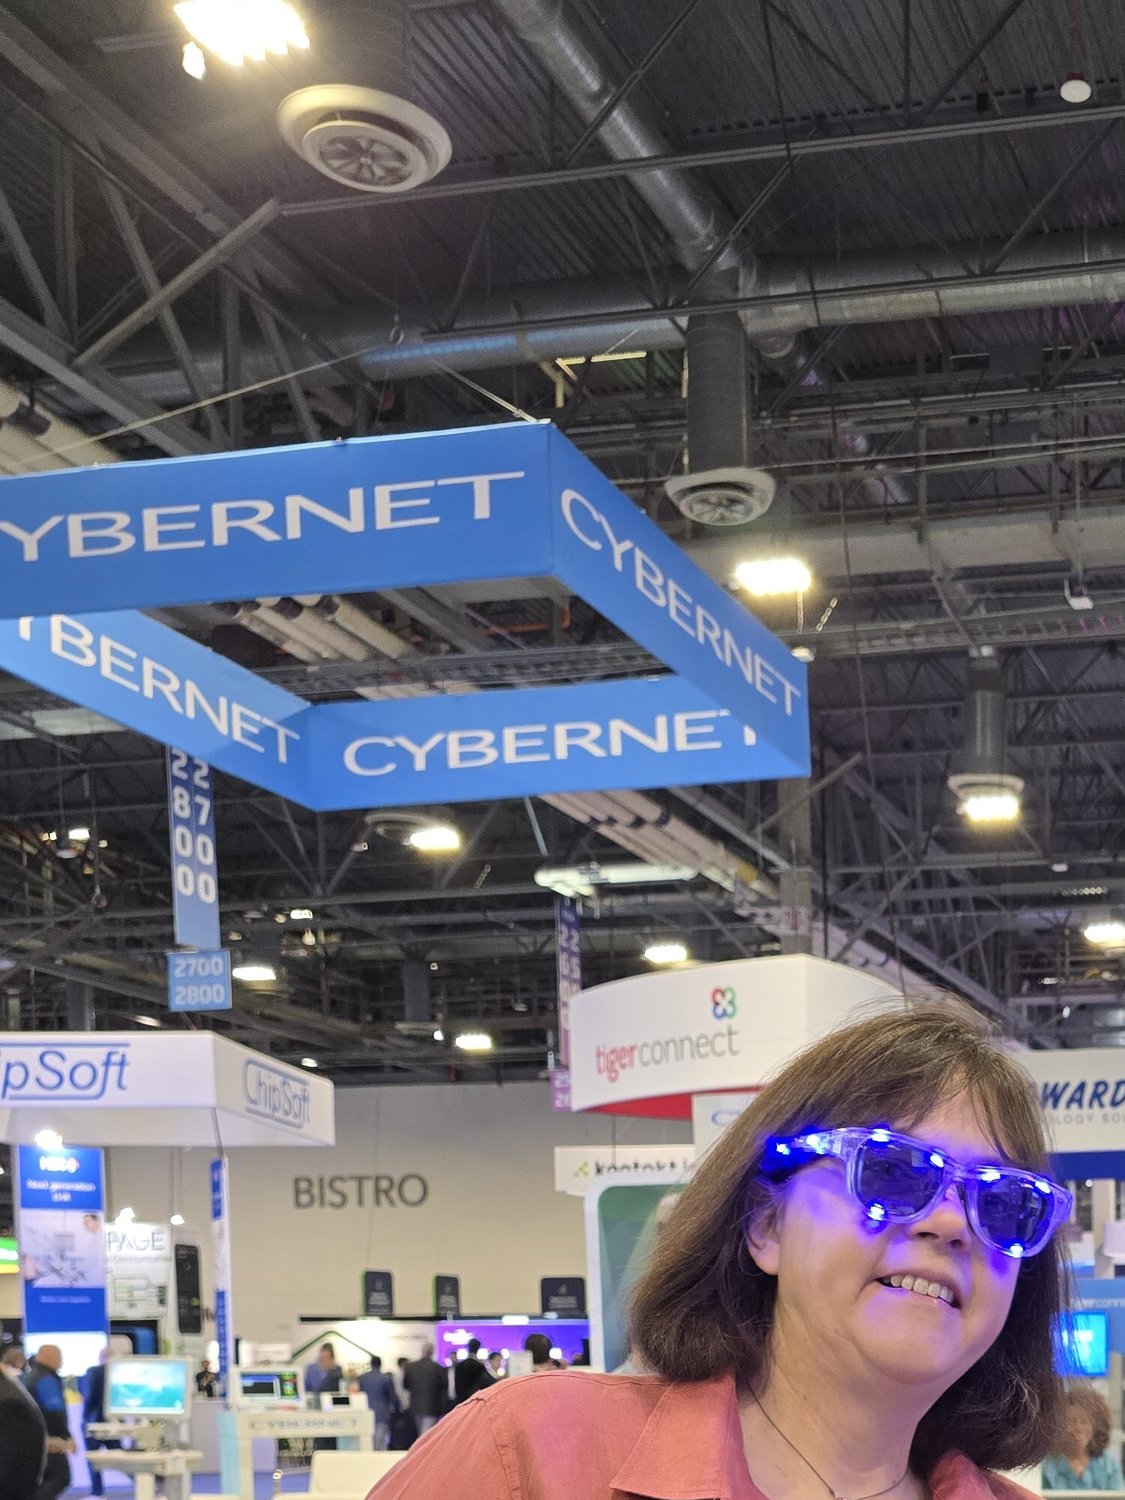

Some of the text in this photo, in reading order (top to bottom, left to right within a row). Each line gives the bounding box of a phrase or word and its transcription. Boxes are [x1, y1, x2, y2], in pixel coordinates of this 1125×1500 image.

[0, 471, 525, 562] YBERNET
[560, 488, 801, 716] CYBERNET
[18, 614, 301, 764] BERNET
[174, 955, 224, 978] 2700
[175, 983, 226, 1006] 2800
[1, 1049, 131, 1100] pSoft
[595, 1024, 741, 1083] tigerconnect
[244, 1060, 311, 1126] ChipSoft
[293, 1174, 430, 1210] BISTRO
